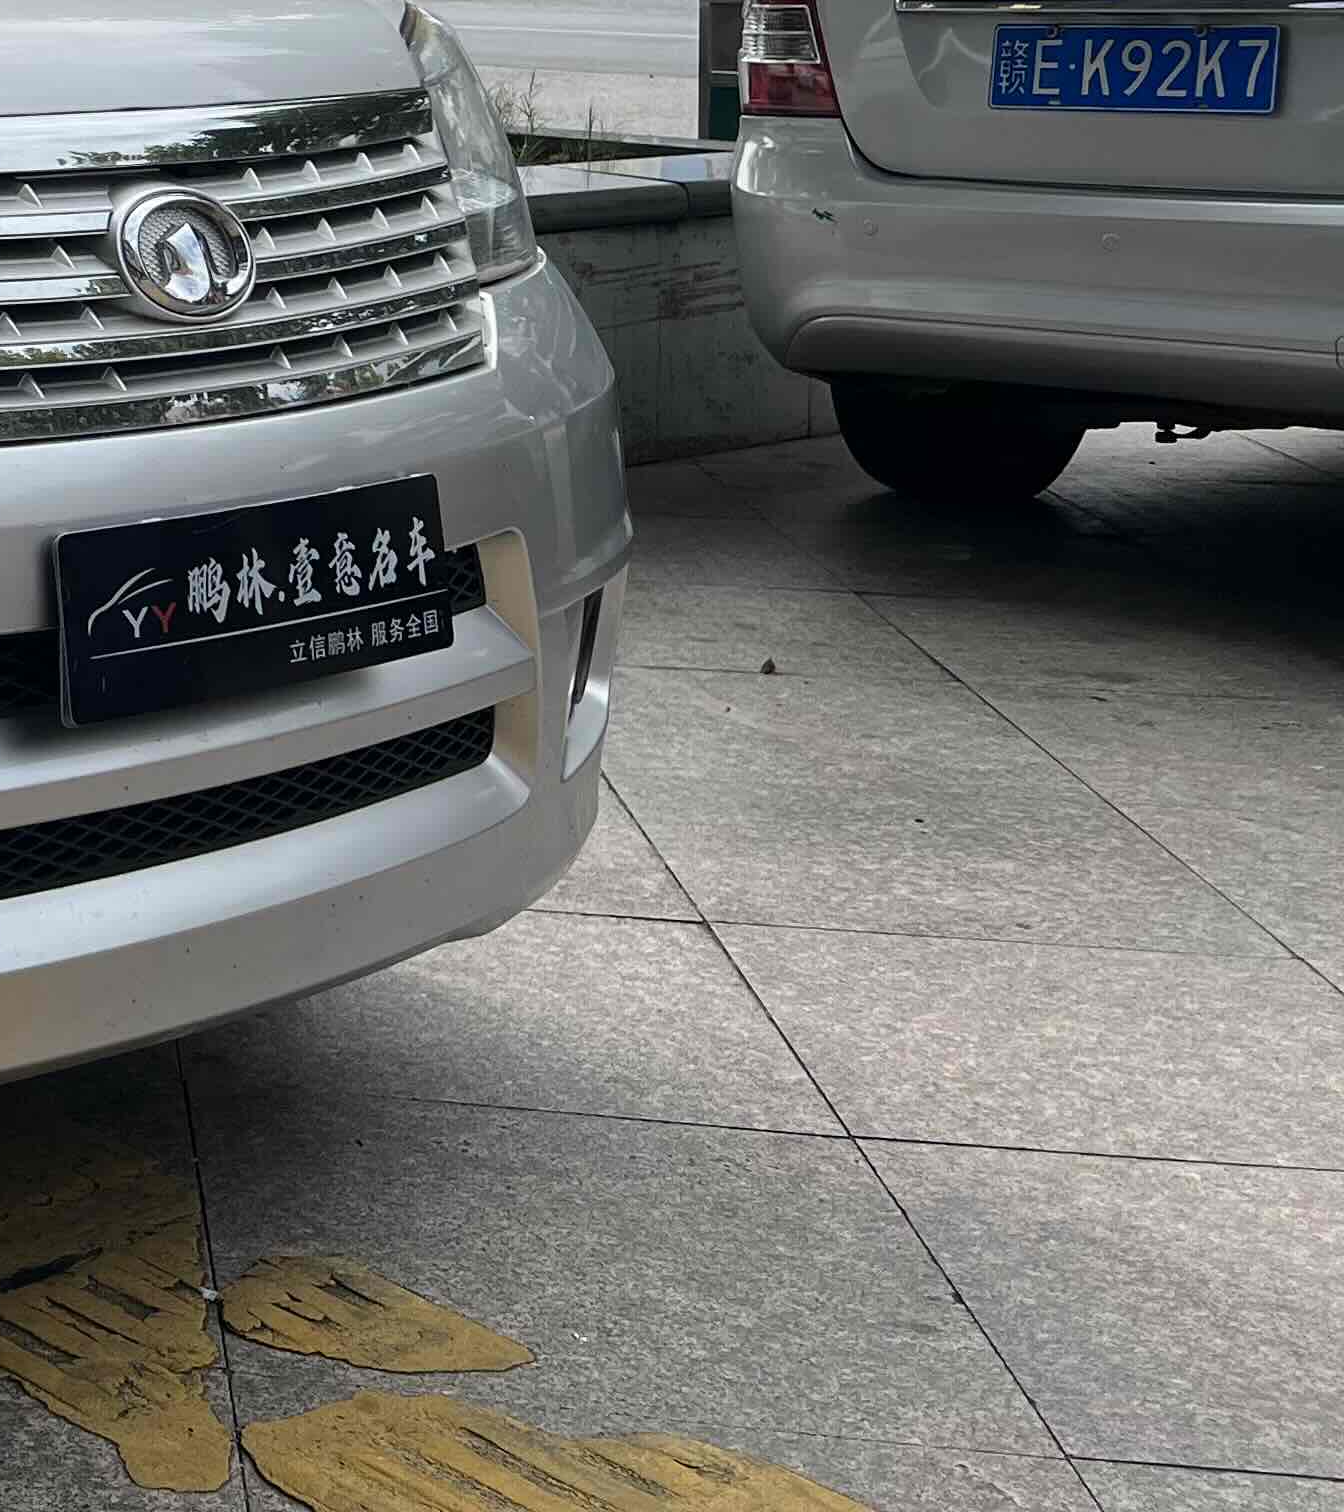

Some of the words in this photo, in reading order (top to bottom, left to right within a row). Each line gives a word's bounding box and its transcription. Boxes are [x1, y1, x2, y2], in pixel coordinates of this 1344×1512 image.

[123, 601, 177, 639] YY
[289, 631, 364, 663] 立信鹏林
[371, 609, 439, 647] 服务全国
